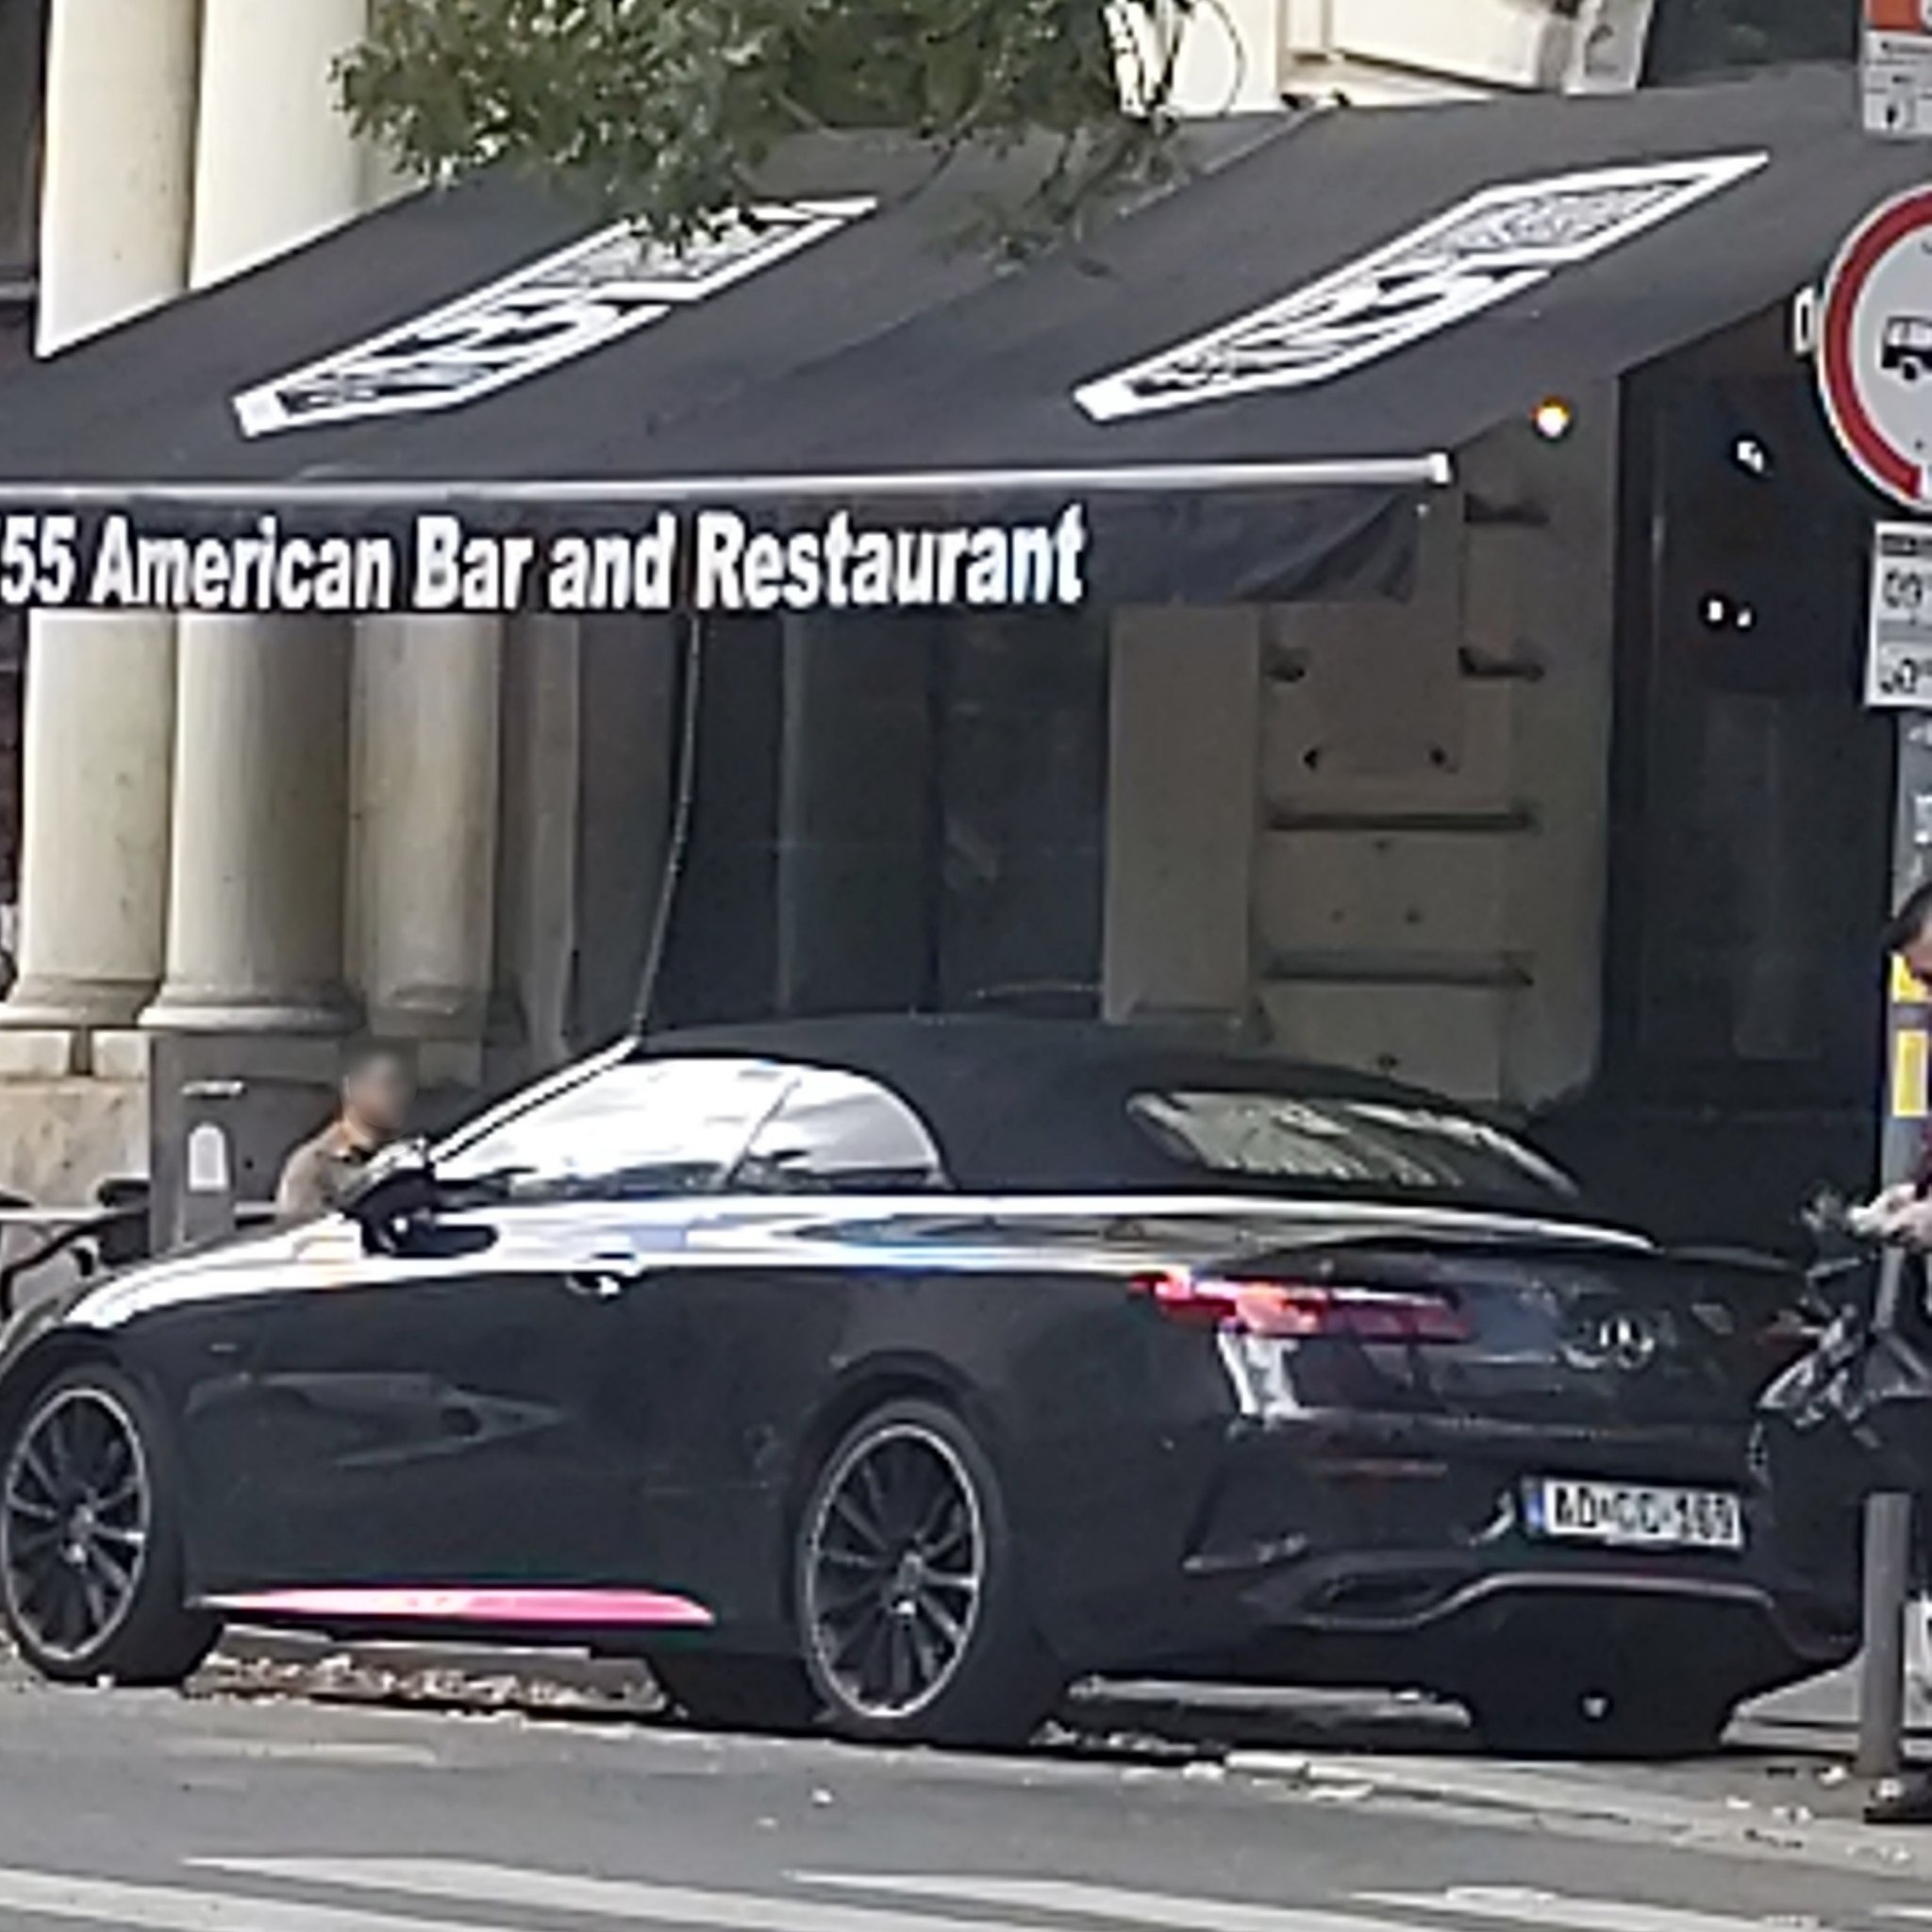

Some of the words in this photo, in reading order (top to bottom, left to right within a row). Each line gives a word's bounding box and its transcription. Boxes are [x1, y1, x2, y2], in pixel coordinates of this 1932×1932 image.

[1, 515, 75, 603] 55
[90, 515, 392, 609] American
[413, 515, 534, 608] Bar
[549, 510, 676, 608] and
[696, 504, 1084, 609] Restaurant
